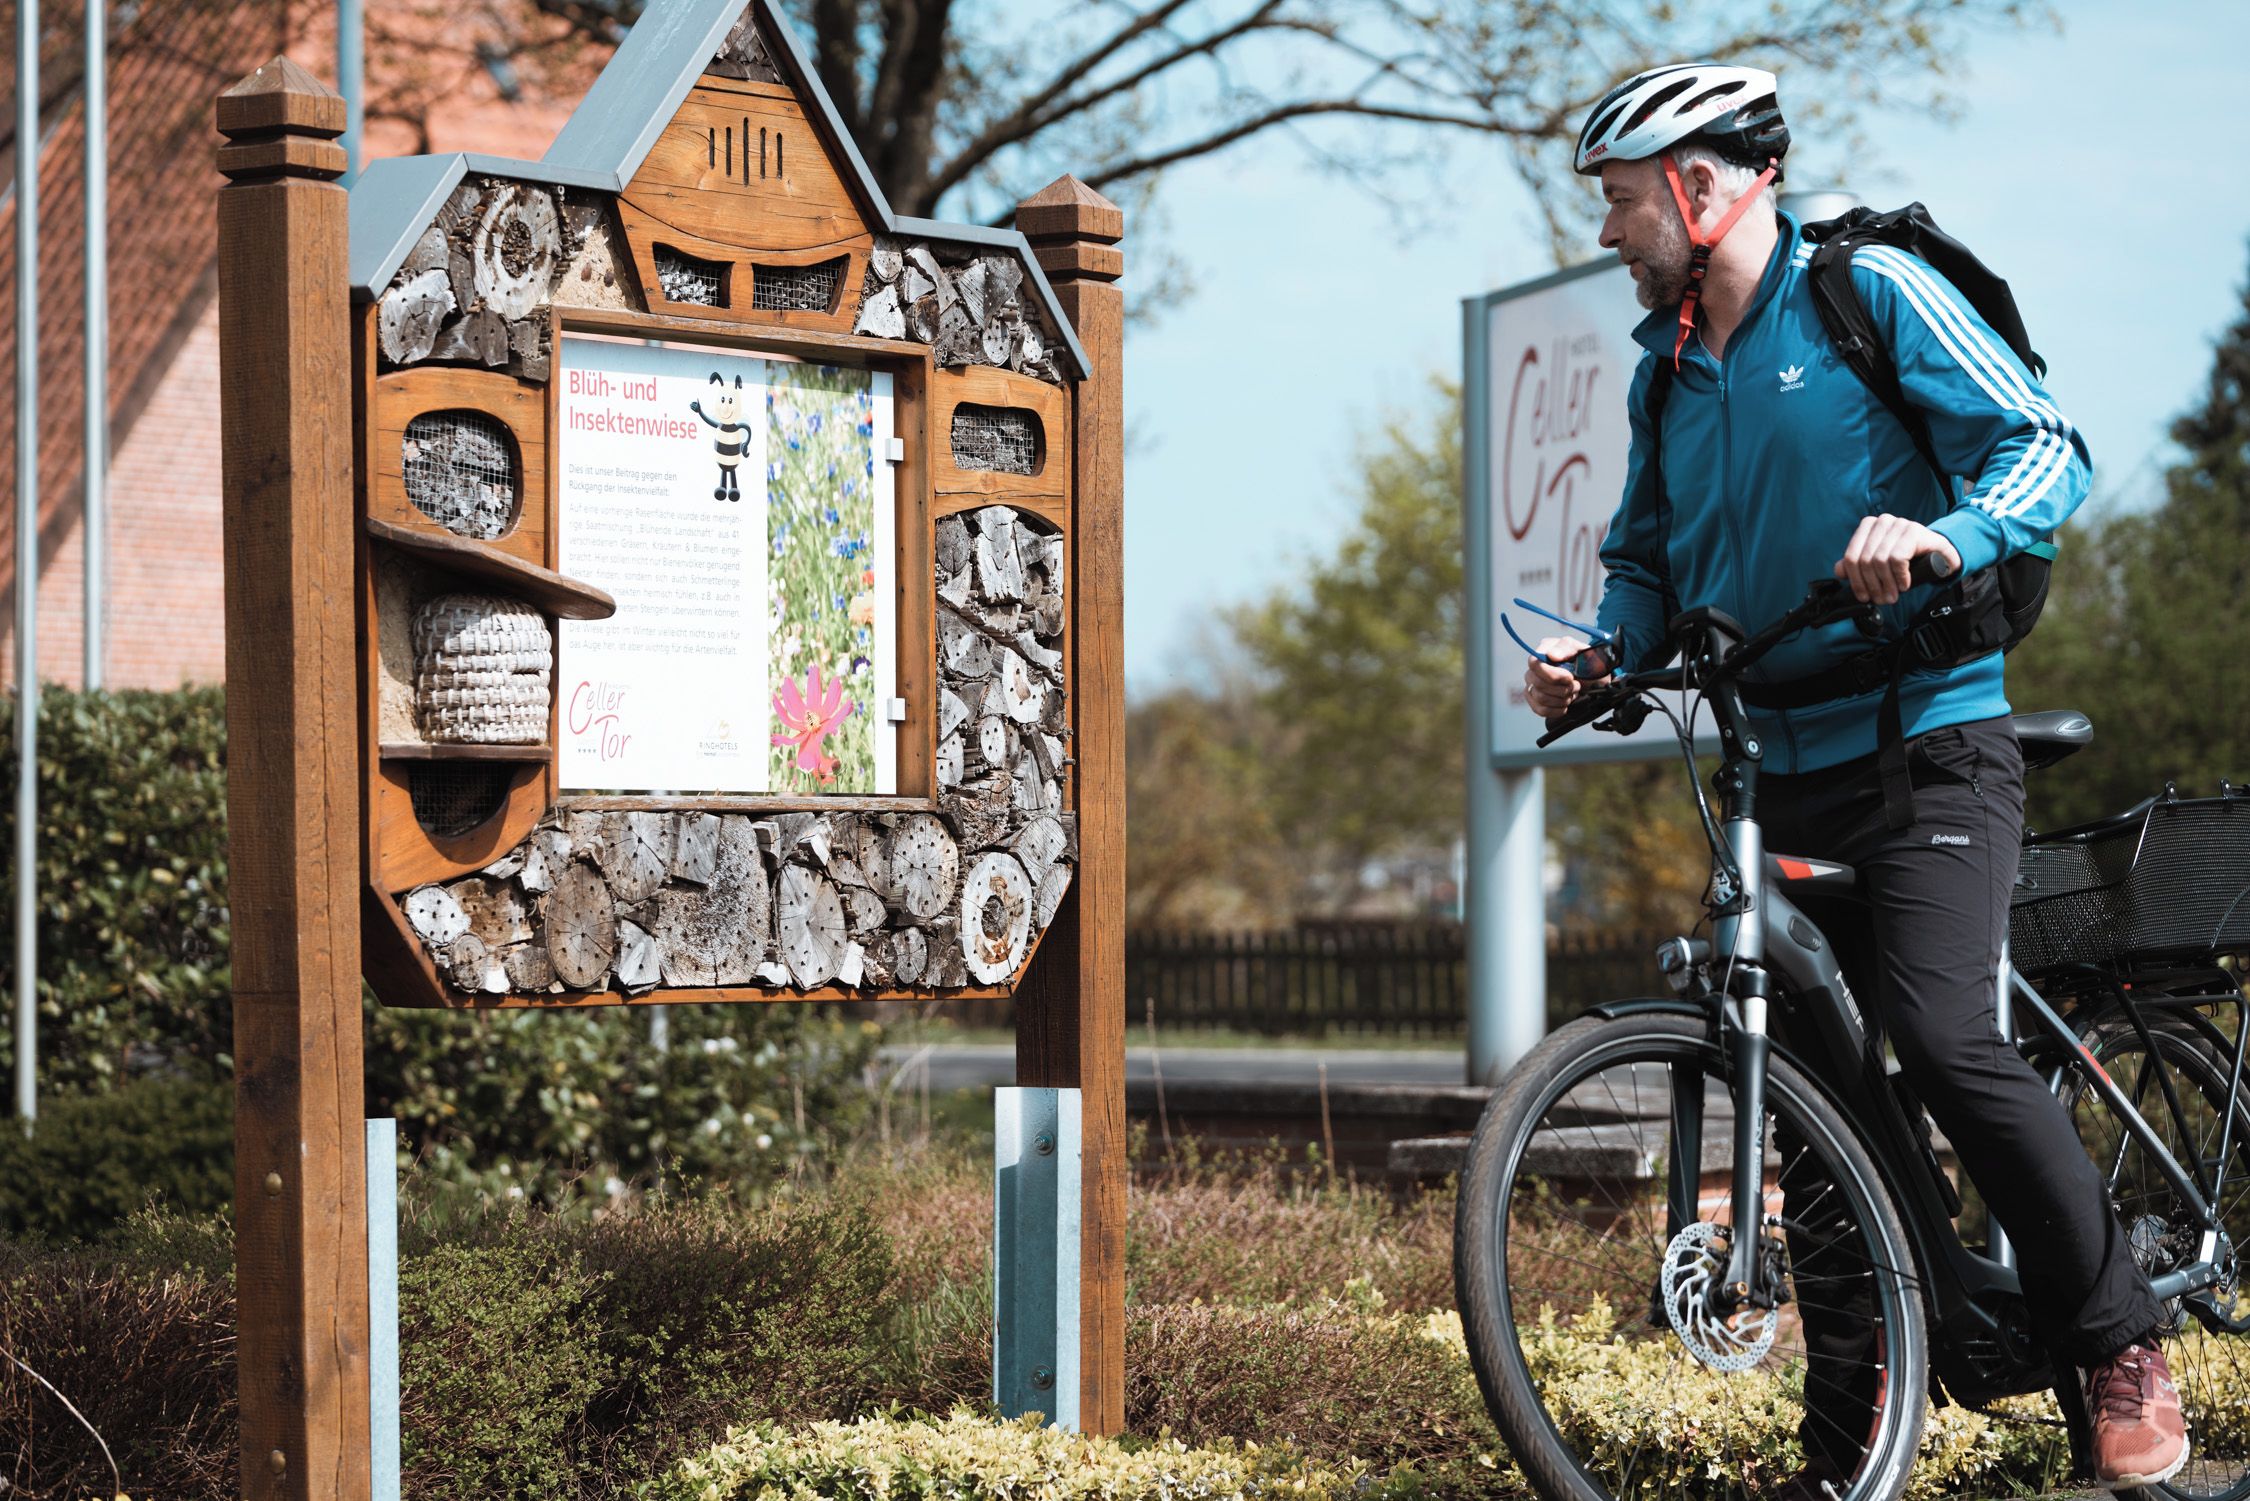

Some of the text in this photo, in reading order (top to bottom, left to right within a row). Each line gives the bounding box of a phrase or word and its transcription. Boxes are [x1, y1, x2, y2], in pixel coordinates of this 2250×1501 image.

[1717, 95, 1748, 112] uvex
[1584, 142, 1609, 161] uvex
[570, 370, 657, 402] Blüh- und
[1779, 381, 1805, 392] adidas
[570, 405, 698, 440] Insektenwiese
[1503, 335, 1601, 541] Celler
[569, 681, 626, 735] Celler
[595, 715, 632, 762] Tor
[1931, 834, 1970, 846] Bergans
